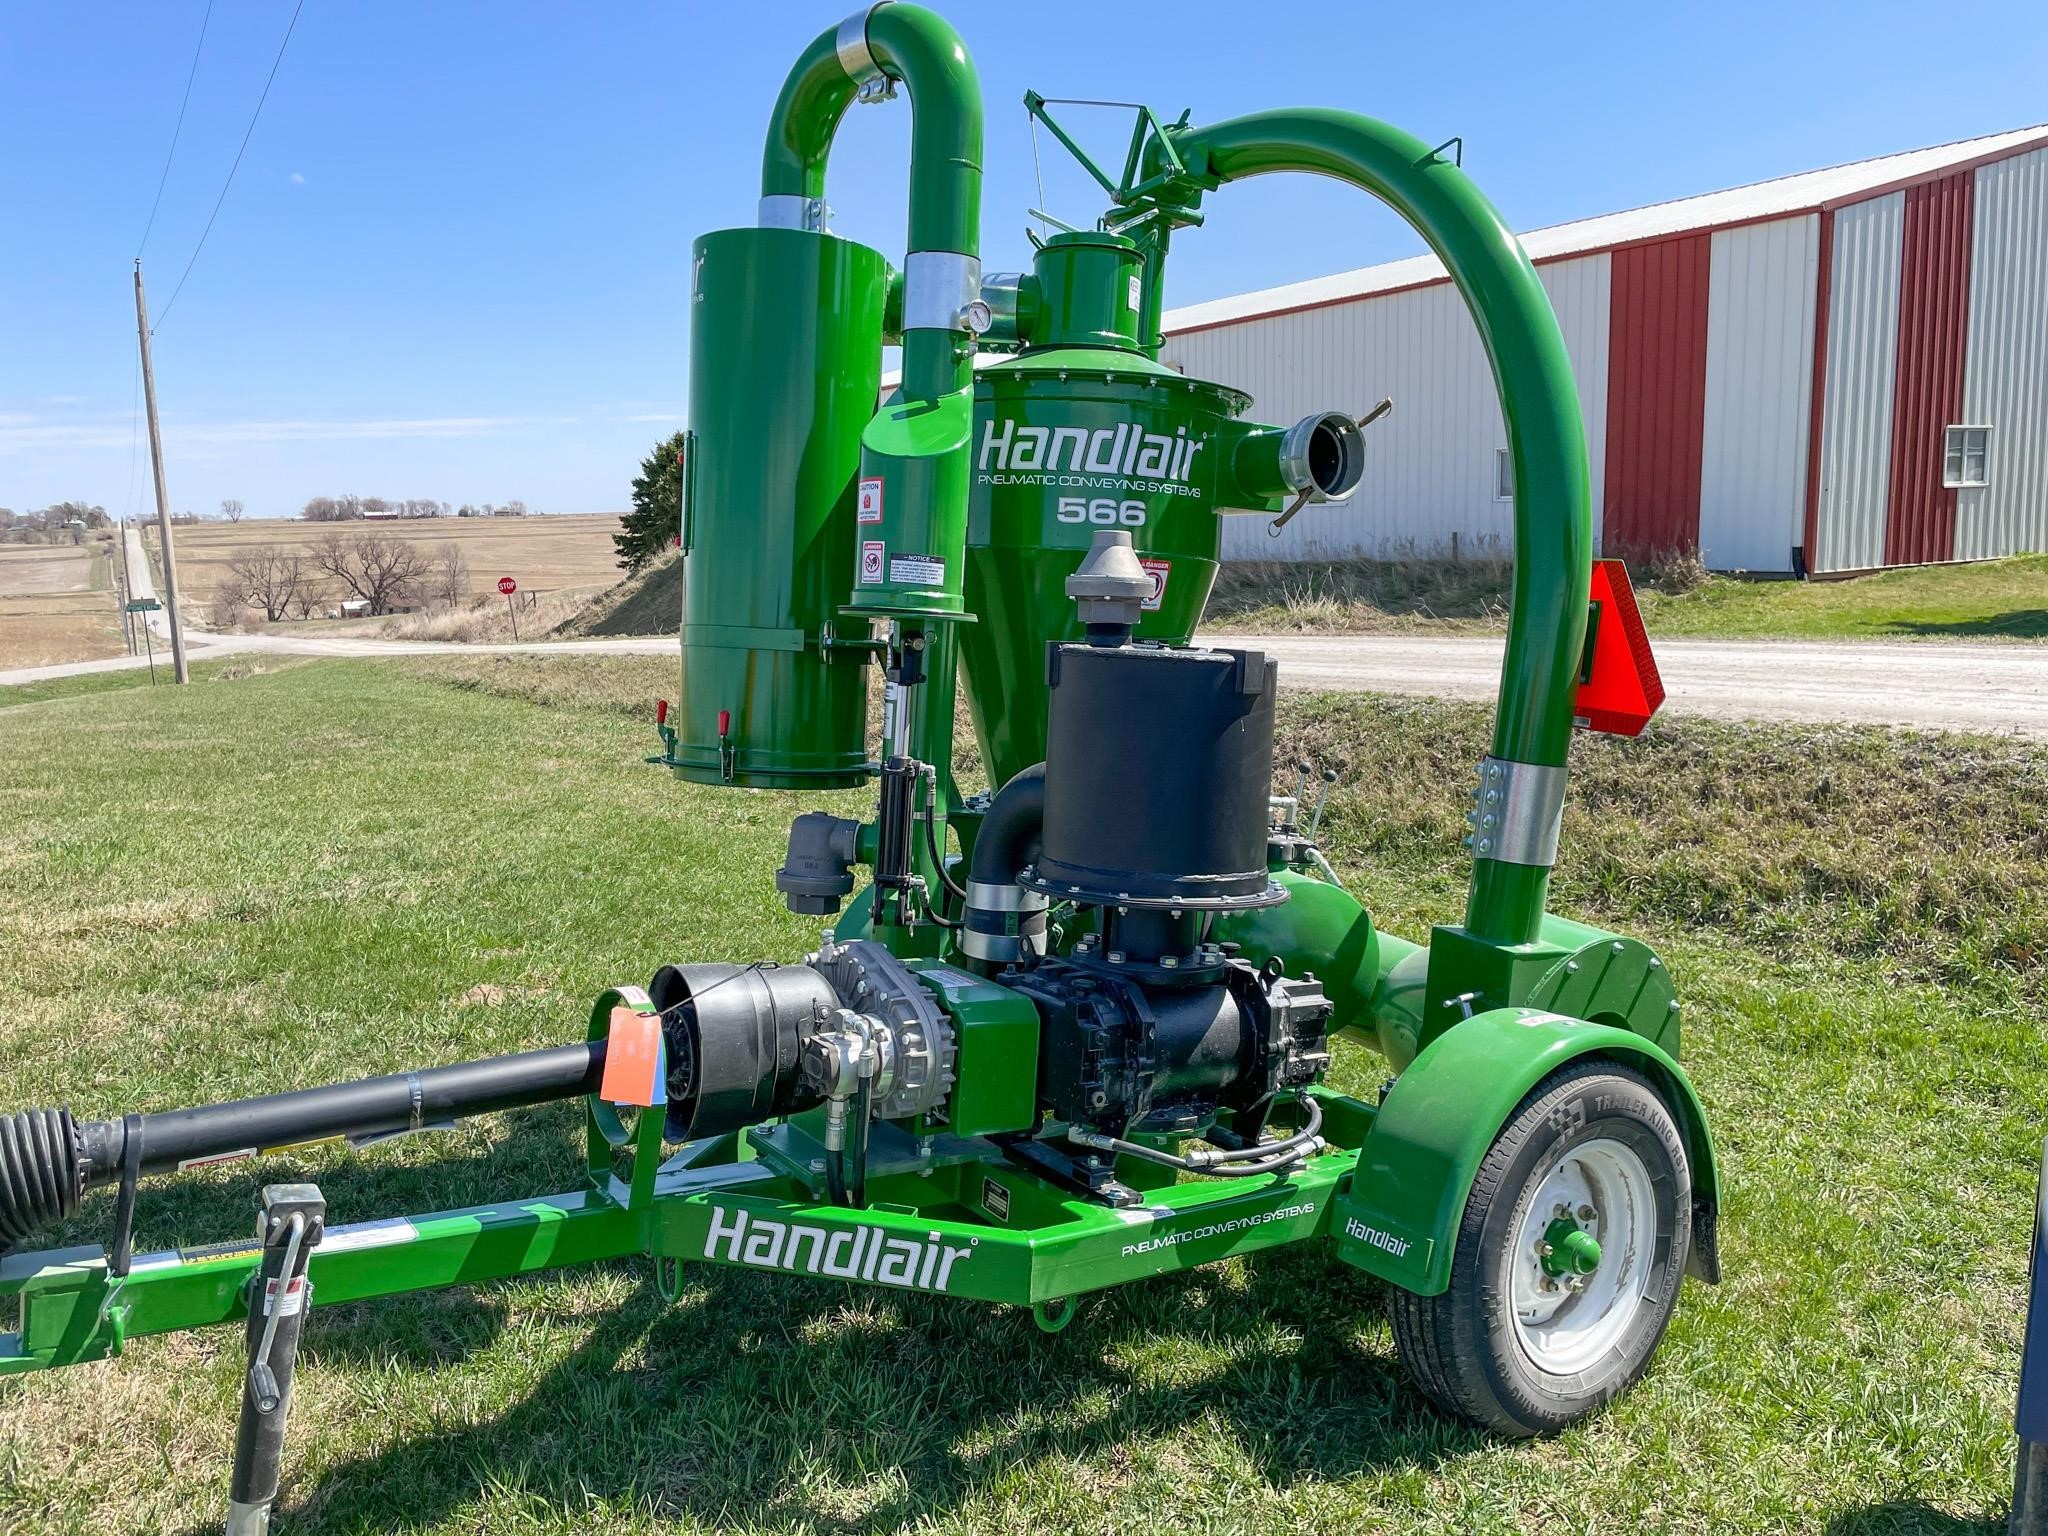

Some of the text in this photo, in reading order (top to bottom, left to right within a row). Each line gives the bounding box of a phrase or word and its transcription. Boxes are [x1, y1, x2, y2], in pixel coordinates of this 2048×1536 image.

[978, 474, 1201, 498] PNEUMATIC CONVEYING SYSTEMS
[1057, 496, 1146, 527] 566
[908, 555, 931, 563] NOTICE
[1145, 561, 1169, 569] DANGER
[499, 581, 515, 591] STOP
[1594, 1094, 1687, 1175] TRAILER KING RST
[1121, 1202, 1315, 1258] PNEUMATIC CONVEYING SYSTEMS
[1345, 1216, 1411, 1258] Handlair
